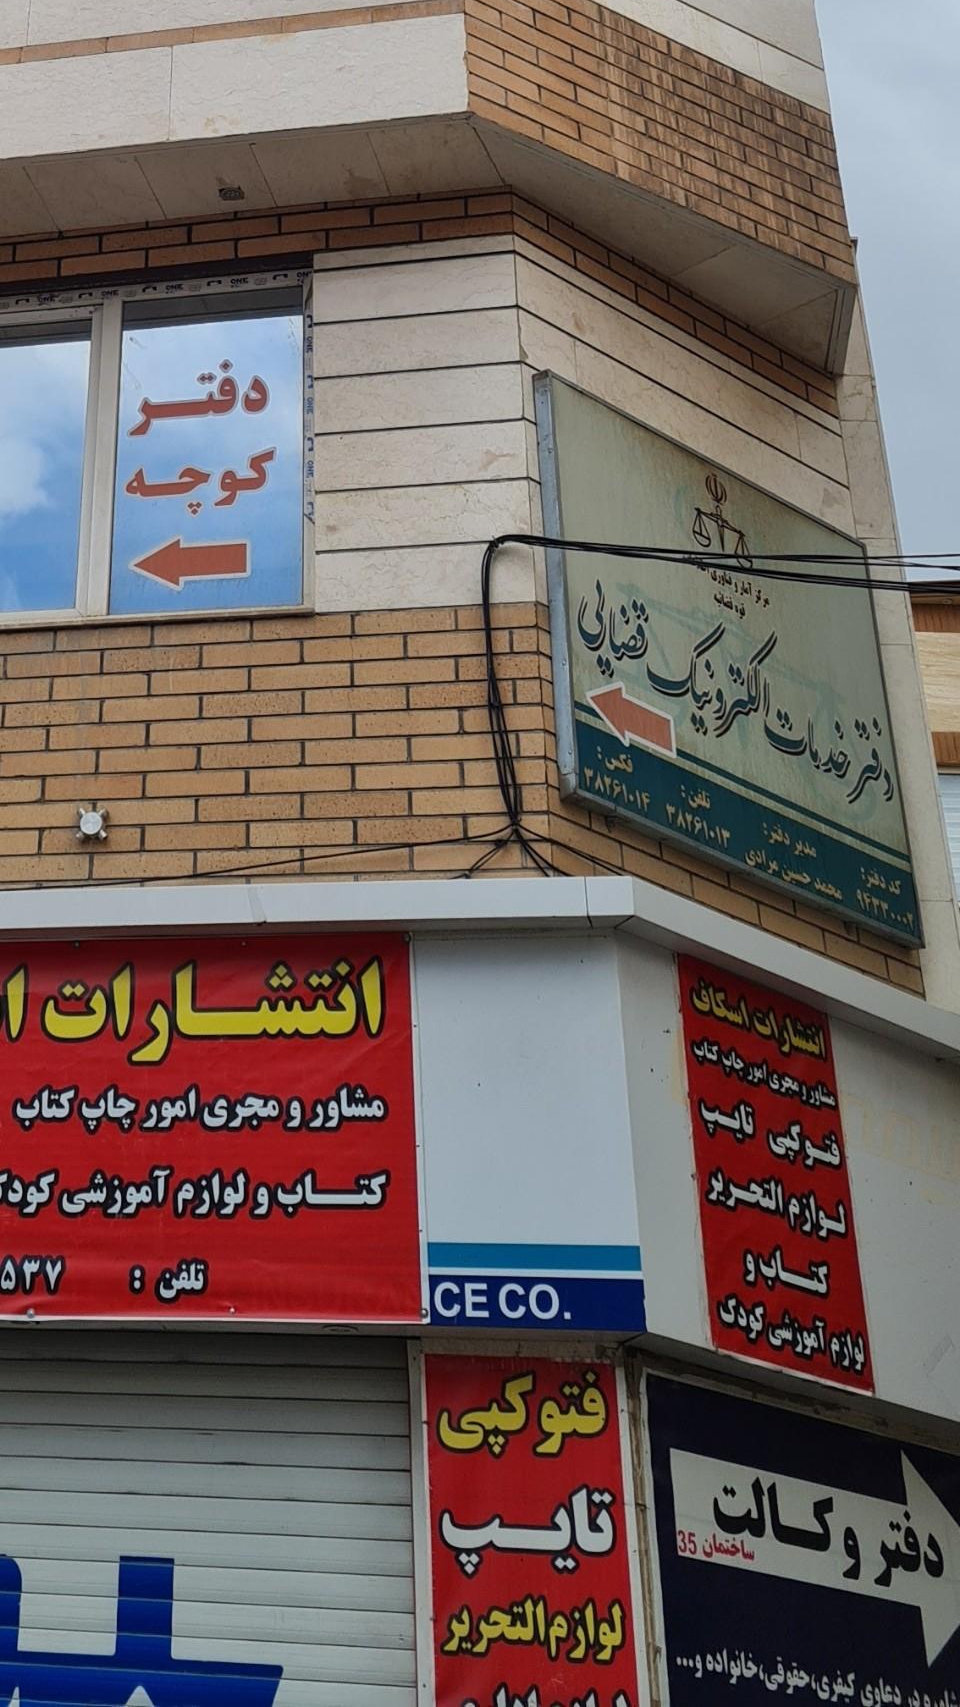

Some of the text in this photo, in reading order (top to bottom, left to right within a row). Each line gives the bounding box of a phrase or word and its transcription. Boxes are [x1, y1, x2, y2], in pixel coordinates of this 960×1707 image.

[127, 358, 270, 439] دفتر
[124, 447, 277, 516] کوچه
[647, 621, 778, 736] الکترونیک
[765, 709, 850, 778] خدمات
[847, 717, 894, 803] دفتر
[745, 849, 780, 874] مرادی
[781, 864, 811, 885] حسین
[41, 958, 385, 1063] انتشارات
[692, 981, 826, 1058] انتشارات اسکاف
[693, 1042, 836, 1106] مشاور و مجری امور چاپ کتاب
[15, 1088, 74, 1128] کتاب
[79, 1093, 136, 1132] چاپ
[143, 1087, 196, 1130] امور
[202, 1087, 279, 1132] مجری
[287, 1099, 301, 1129] و
[310, 1085, 385, 1129] مشاور
[701, 1102, 841, 1168] فتوکپی تایپ
[62, 1170, 170, 1216] آموزشی
[176, 1173, 244, 1216] لوازم
[254, 1186, 269, 1216] و
[277, 1171, 387, 1216] کتاب
[708, 1171, 847, 1237] لوازم التحریر
[158, 1261, 207, 1298] تلفن
[746, 1249, 828, 1294] کتاب و
[498, 1282, 572, 1321] CO.
[719, 1298, 865, 1370] لوازم آموزشی کودک
[439, 1371, 607, 1456] فتوکپی
[440, 1488, 615, 1576] تایپ
[677, 1530, 755, 1562] ساختمان 35
[713, 1477, 944, 1588] دفتر وکالت
[442, 1597, 623, 1661] لوازم التحریر
[860, 1677, 902, 1707] دعاوی
